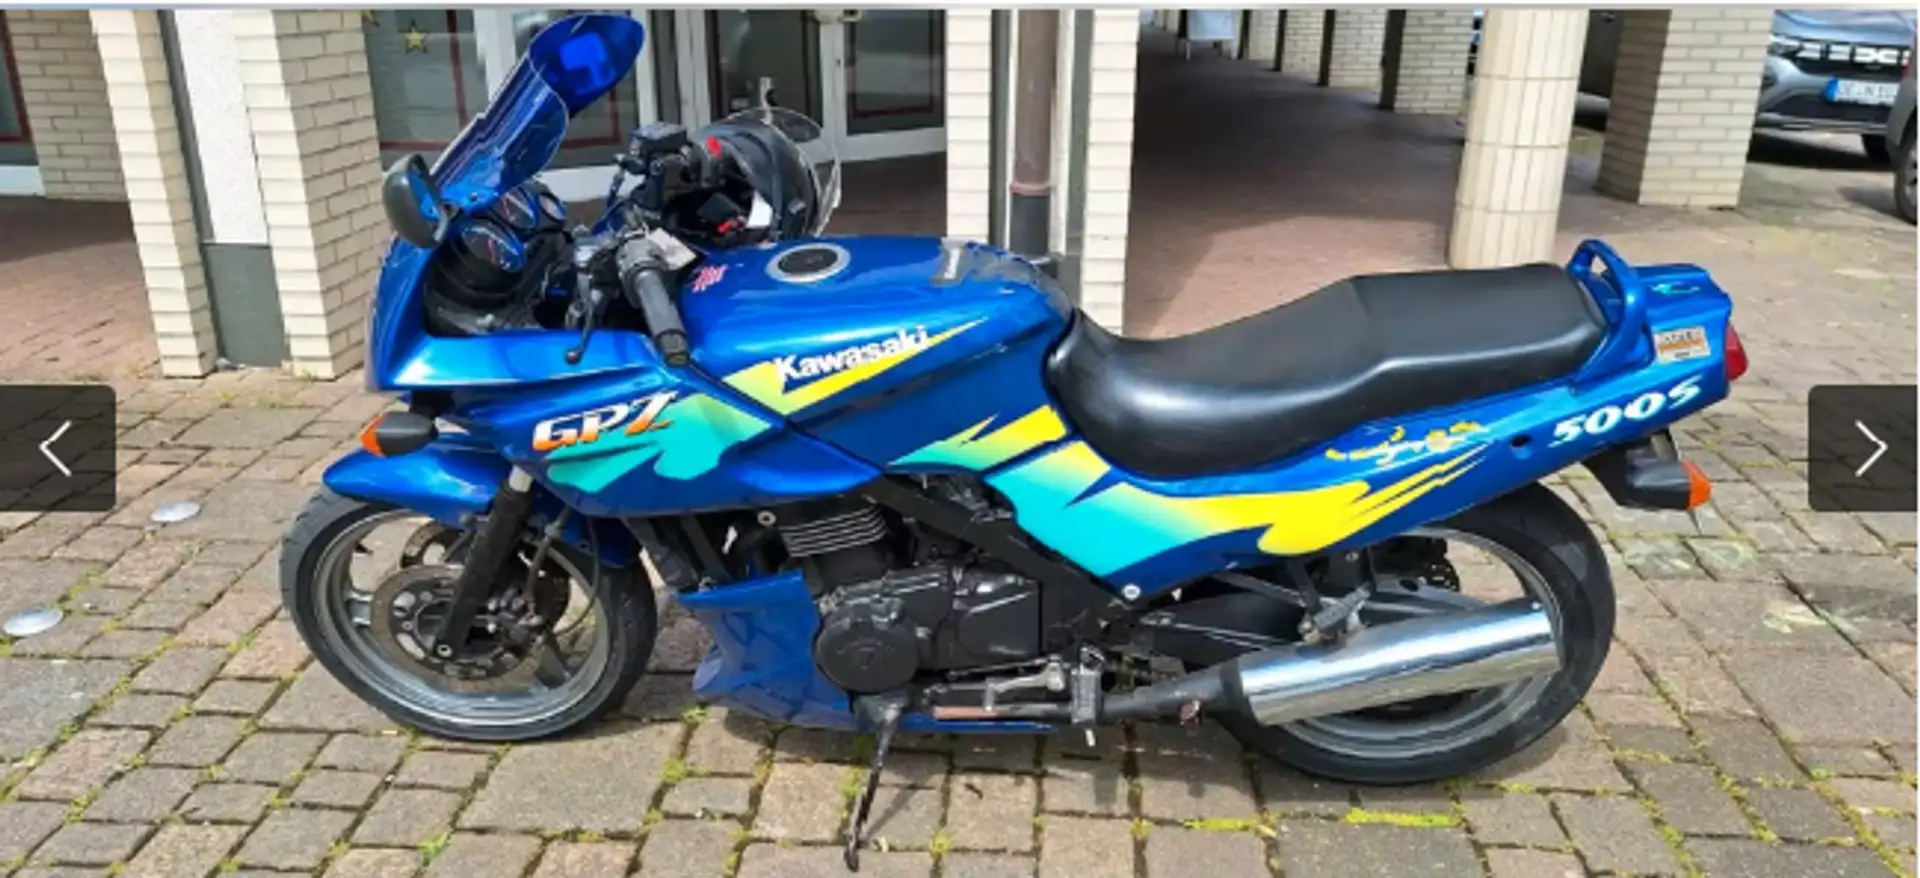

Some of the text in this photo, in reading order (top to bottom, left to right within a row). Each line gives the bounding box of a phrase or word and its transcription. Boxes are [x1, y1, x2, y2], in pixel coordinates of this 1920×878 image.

[774, 325, 929, 380] Kawasaki
[532, 389, 679, 452] GPZ
[1547, 373, 1703, 448] 500S
